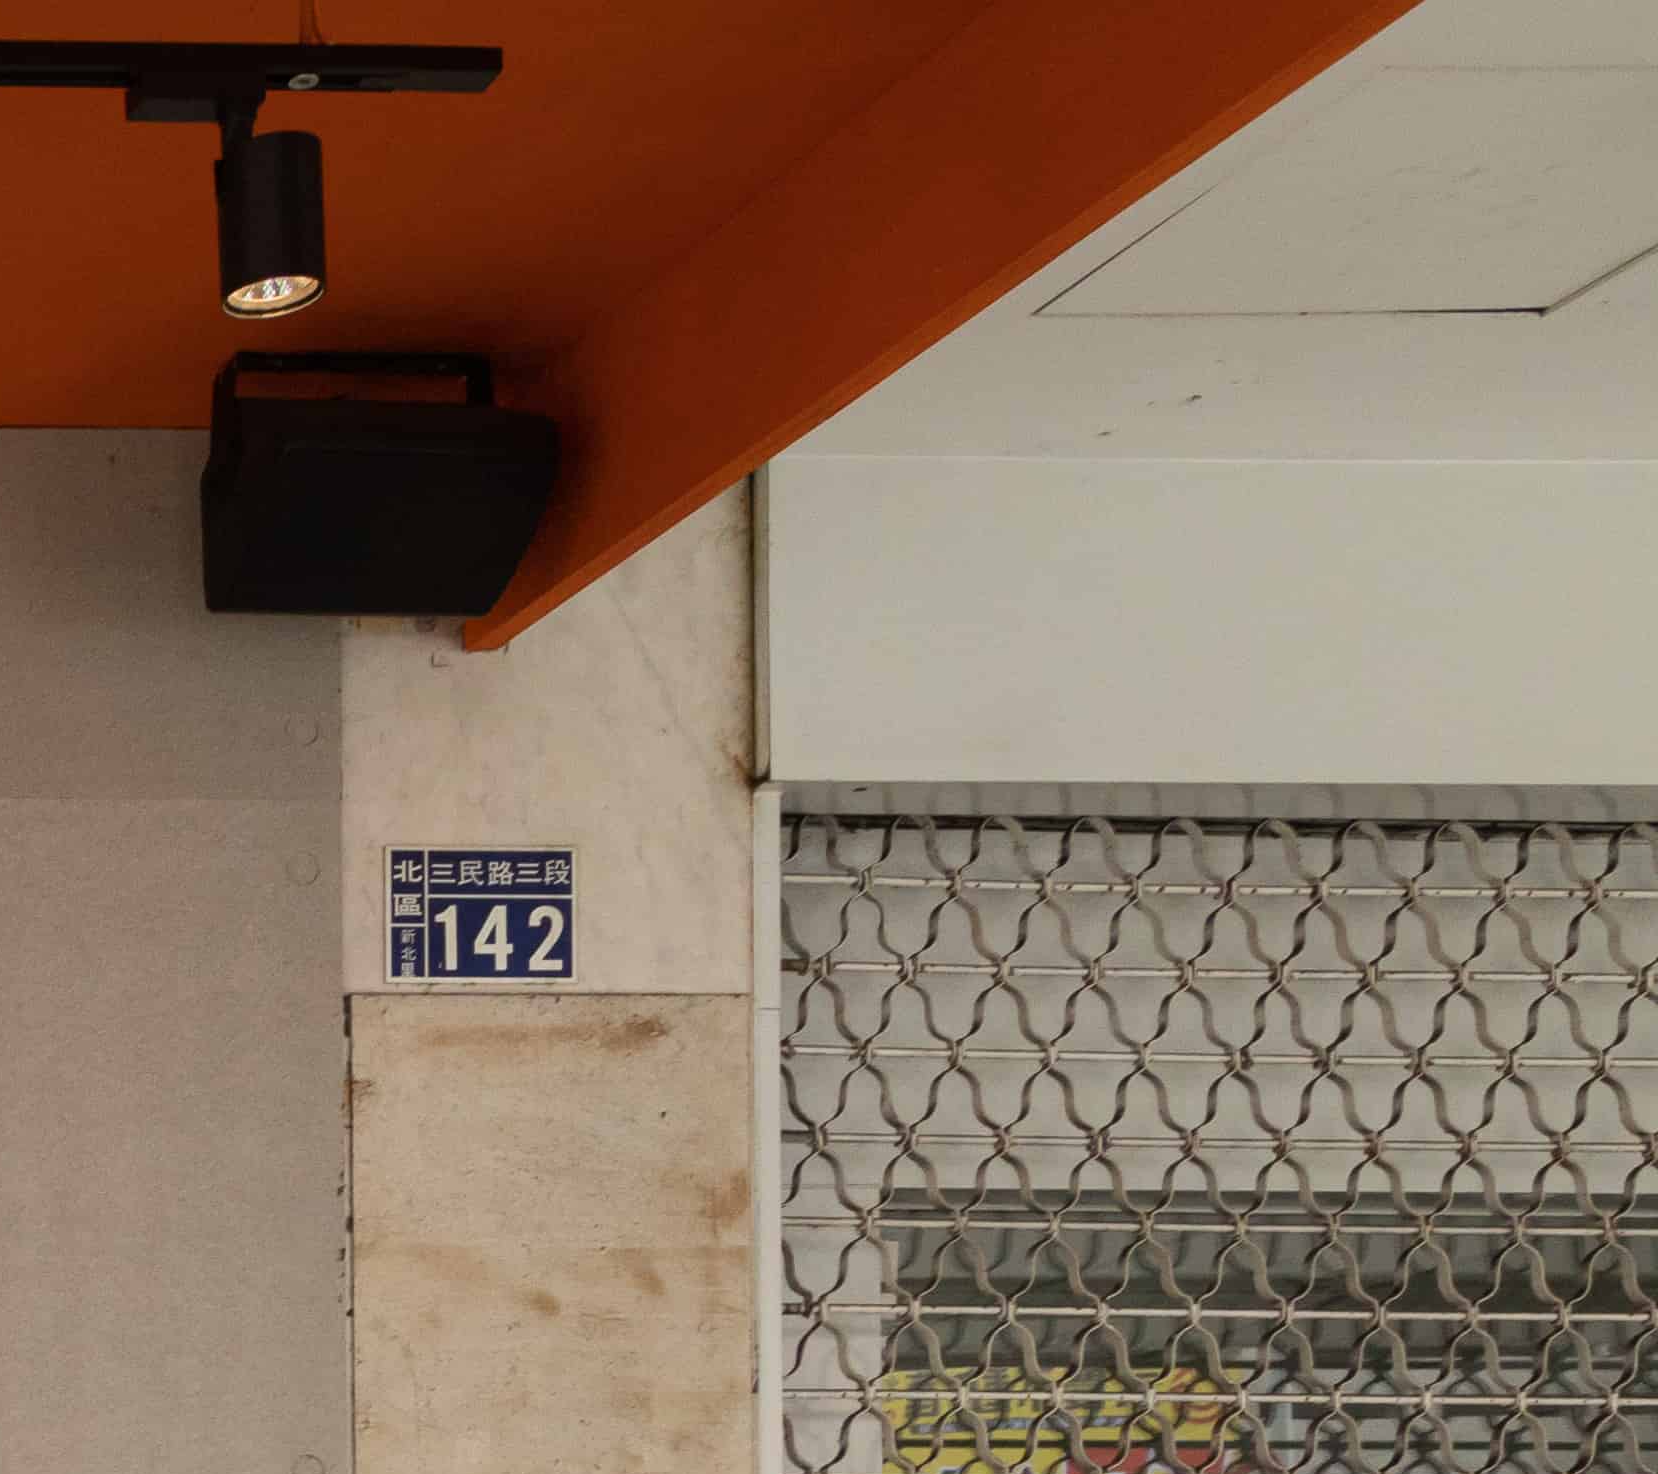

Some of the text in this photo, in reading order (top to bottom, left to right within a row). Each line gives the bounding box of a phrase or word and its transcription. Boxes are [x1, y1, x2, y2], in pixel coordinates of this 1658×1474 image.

[393, 860, 423, 917] 北區
[429, 859, 571, 886] 三民路三段
[434, 904, 565, 971] 142
